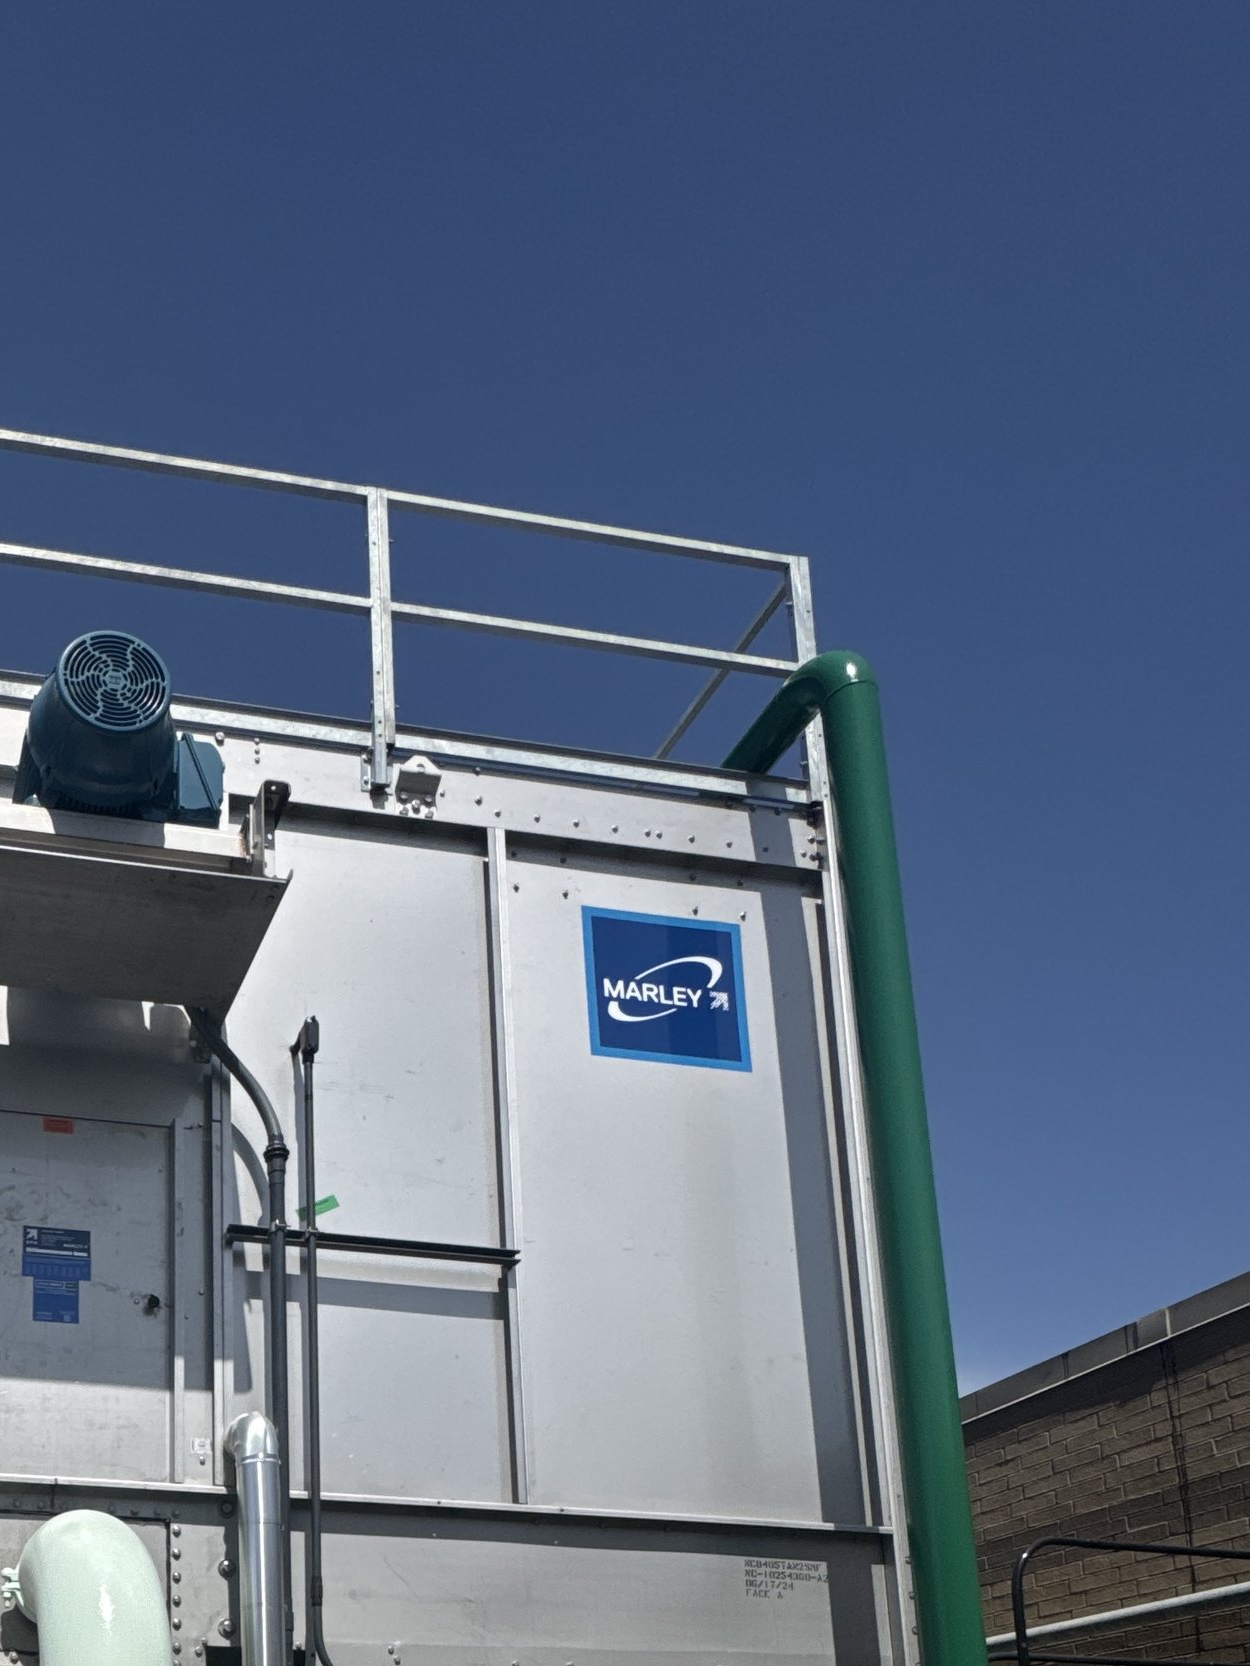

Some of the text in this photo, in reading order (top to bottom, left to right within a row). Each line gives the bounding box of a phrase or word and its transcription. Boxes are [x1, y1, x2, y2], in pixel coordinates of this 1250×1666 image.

[603, 978, 702, 1008] MARLEY
[746, 1589, 784, 1599] FACE A
